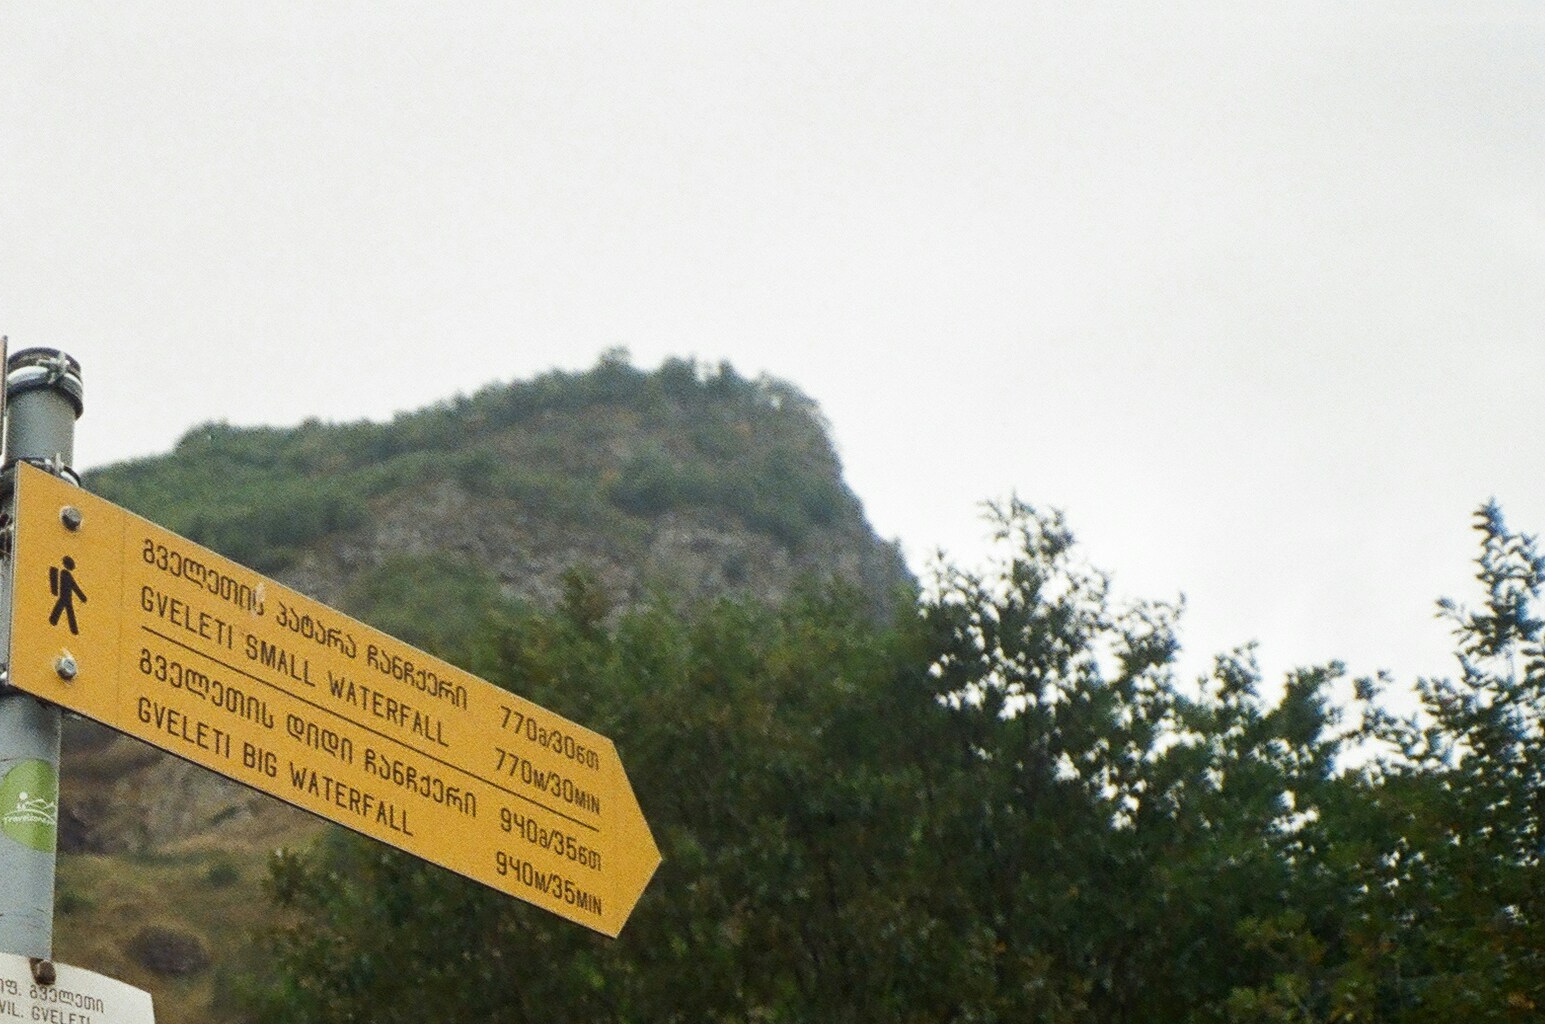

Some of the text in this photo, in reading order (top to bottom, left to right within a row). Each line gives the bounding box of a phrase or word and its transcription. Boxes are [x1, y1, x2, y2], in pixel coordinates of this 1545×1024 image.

[142, 586, 233, 649] GVELETI
[246, 635, 316, 688] SMALL
[329, 672, 449, 747] WATERFALL
[143, 539, 264, 616] გველეთის
[277, 603, 356, 659] პატარა
[368, 645, 466, 710] ჩანჩქერი
[138, 697, 230, 758] GVELETI
[244, 741, 277, 777] BIG
[290, 762, 414, 836] WATERFALL
[140, 649, 273, 729] გველეთის
[287, 714, 352, 763] დიდი
[365, 749, 477, 817] ჩანჩქერი
[30, 984, 104, 1013] გველეთი
